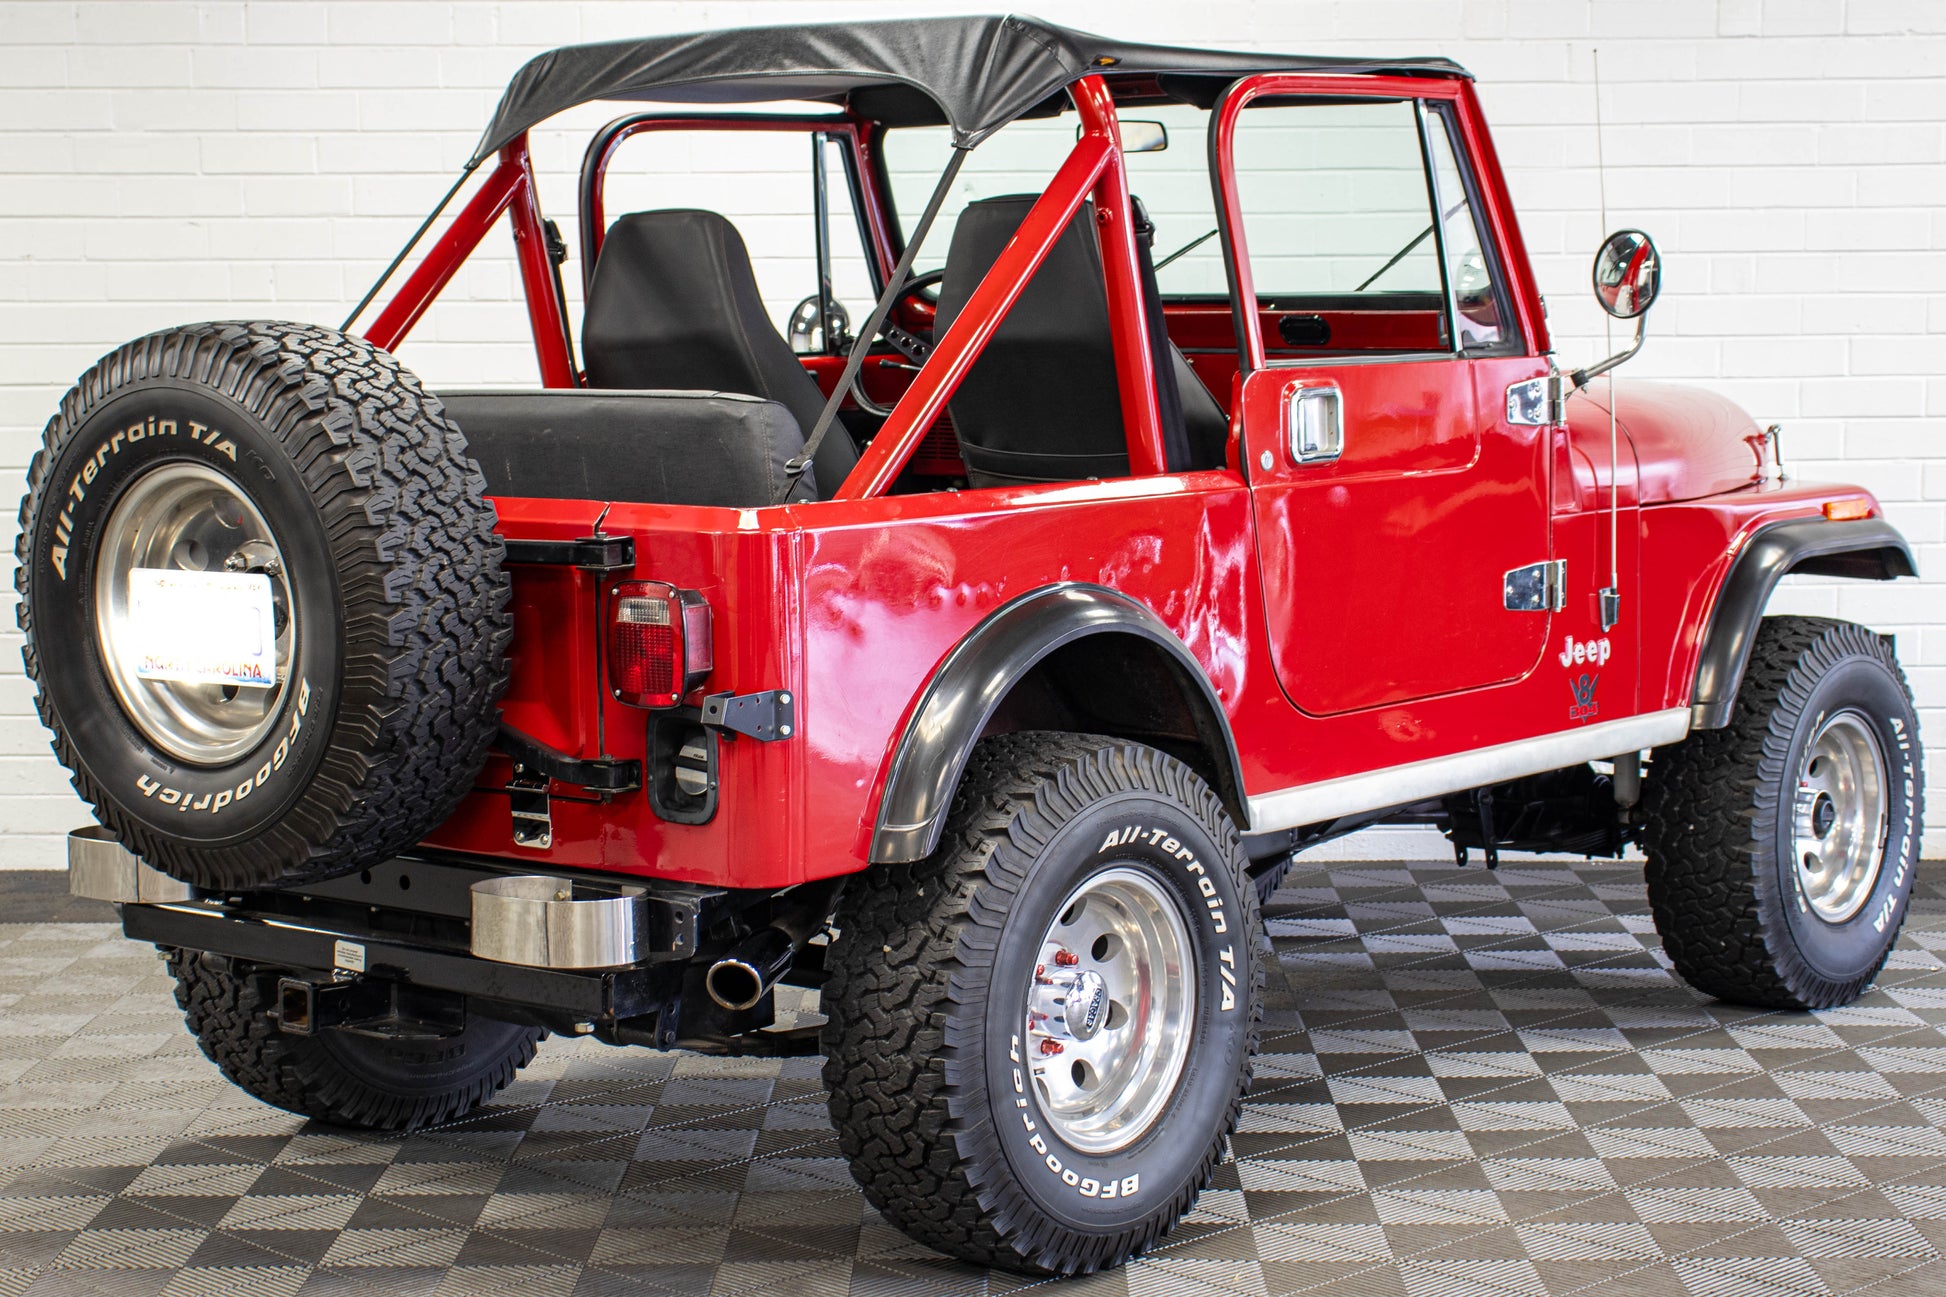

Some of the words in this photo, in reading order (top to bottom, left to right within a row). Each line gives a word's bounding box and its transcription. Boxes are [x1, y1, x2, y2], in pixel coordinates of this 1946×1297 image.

[52, 416, 177, 581] All-Terrain
[188, 420, 238, 463] T/A
[144, 654, 190, 672] NOR
[197, 658, 263, 679] ROLINA
[1558, 634, 1611, 669] Jeep
[1569, 673, 1599, 724] V8
[136, 677, 311, 814] BFGoodrich
[1569, 702, 1599, 720] 304
[1889, 716, 1916, 888] All-Terrain
[1098, 825, 1228, 934] All-Terrain
[1218, 944, 1237, 1012] T/A
[1872, 893, 1899, 933] T/A
[1008, 1034, 1140, 1199] BFGoodrich
